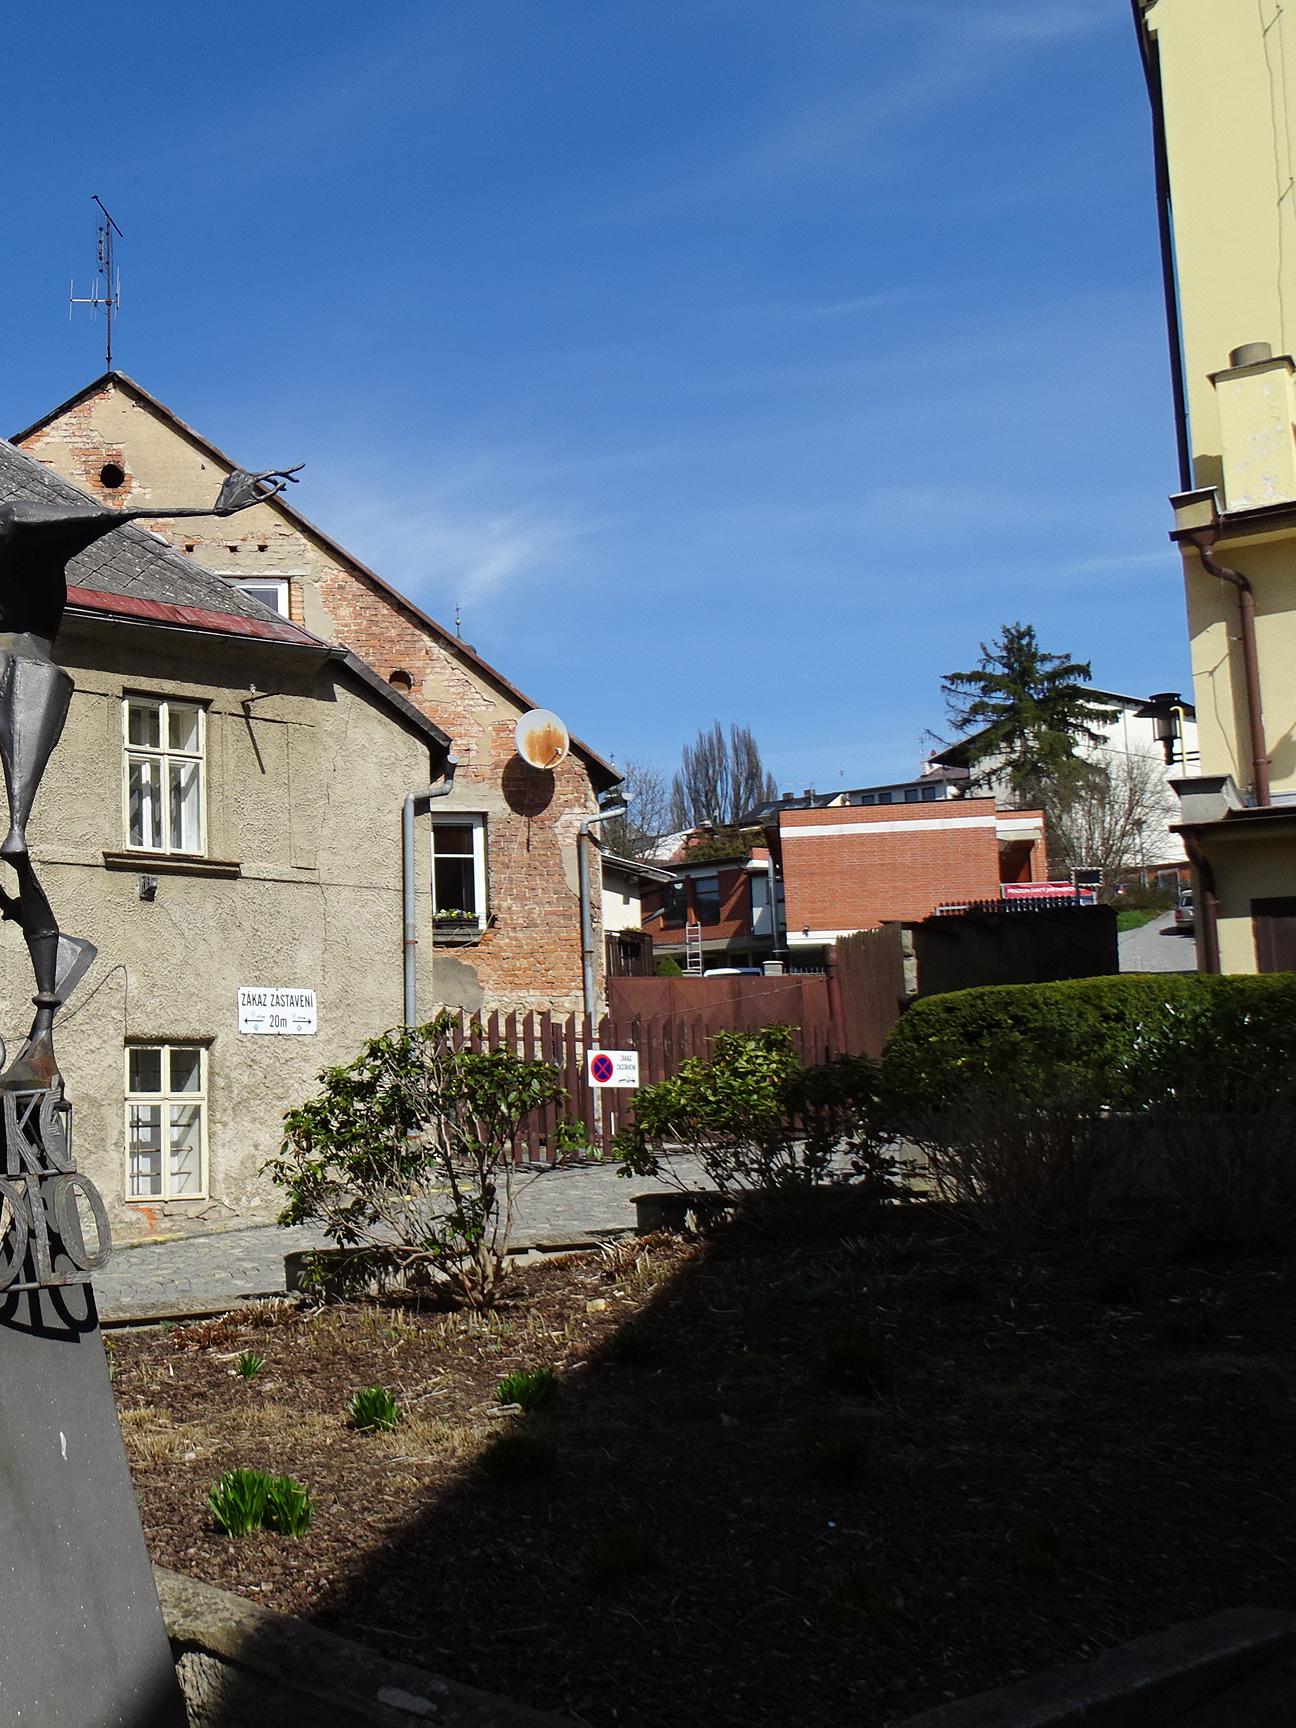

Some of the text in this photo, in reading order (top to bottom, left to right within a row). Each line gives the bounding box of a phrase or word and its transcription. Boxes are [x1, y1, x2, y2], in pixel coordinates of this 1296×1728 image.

[241, 991, 314, 1008] ZÁKAZ ZASTAVENÍ
[269, 1014, 288, 1028] 20m
